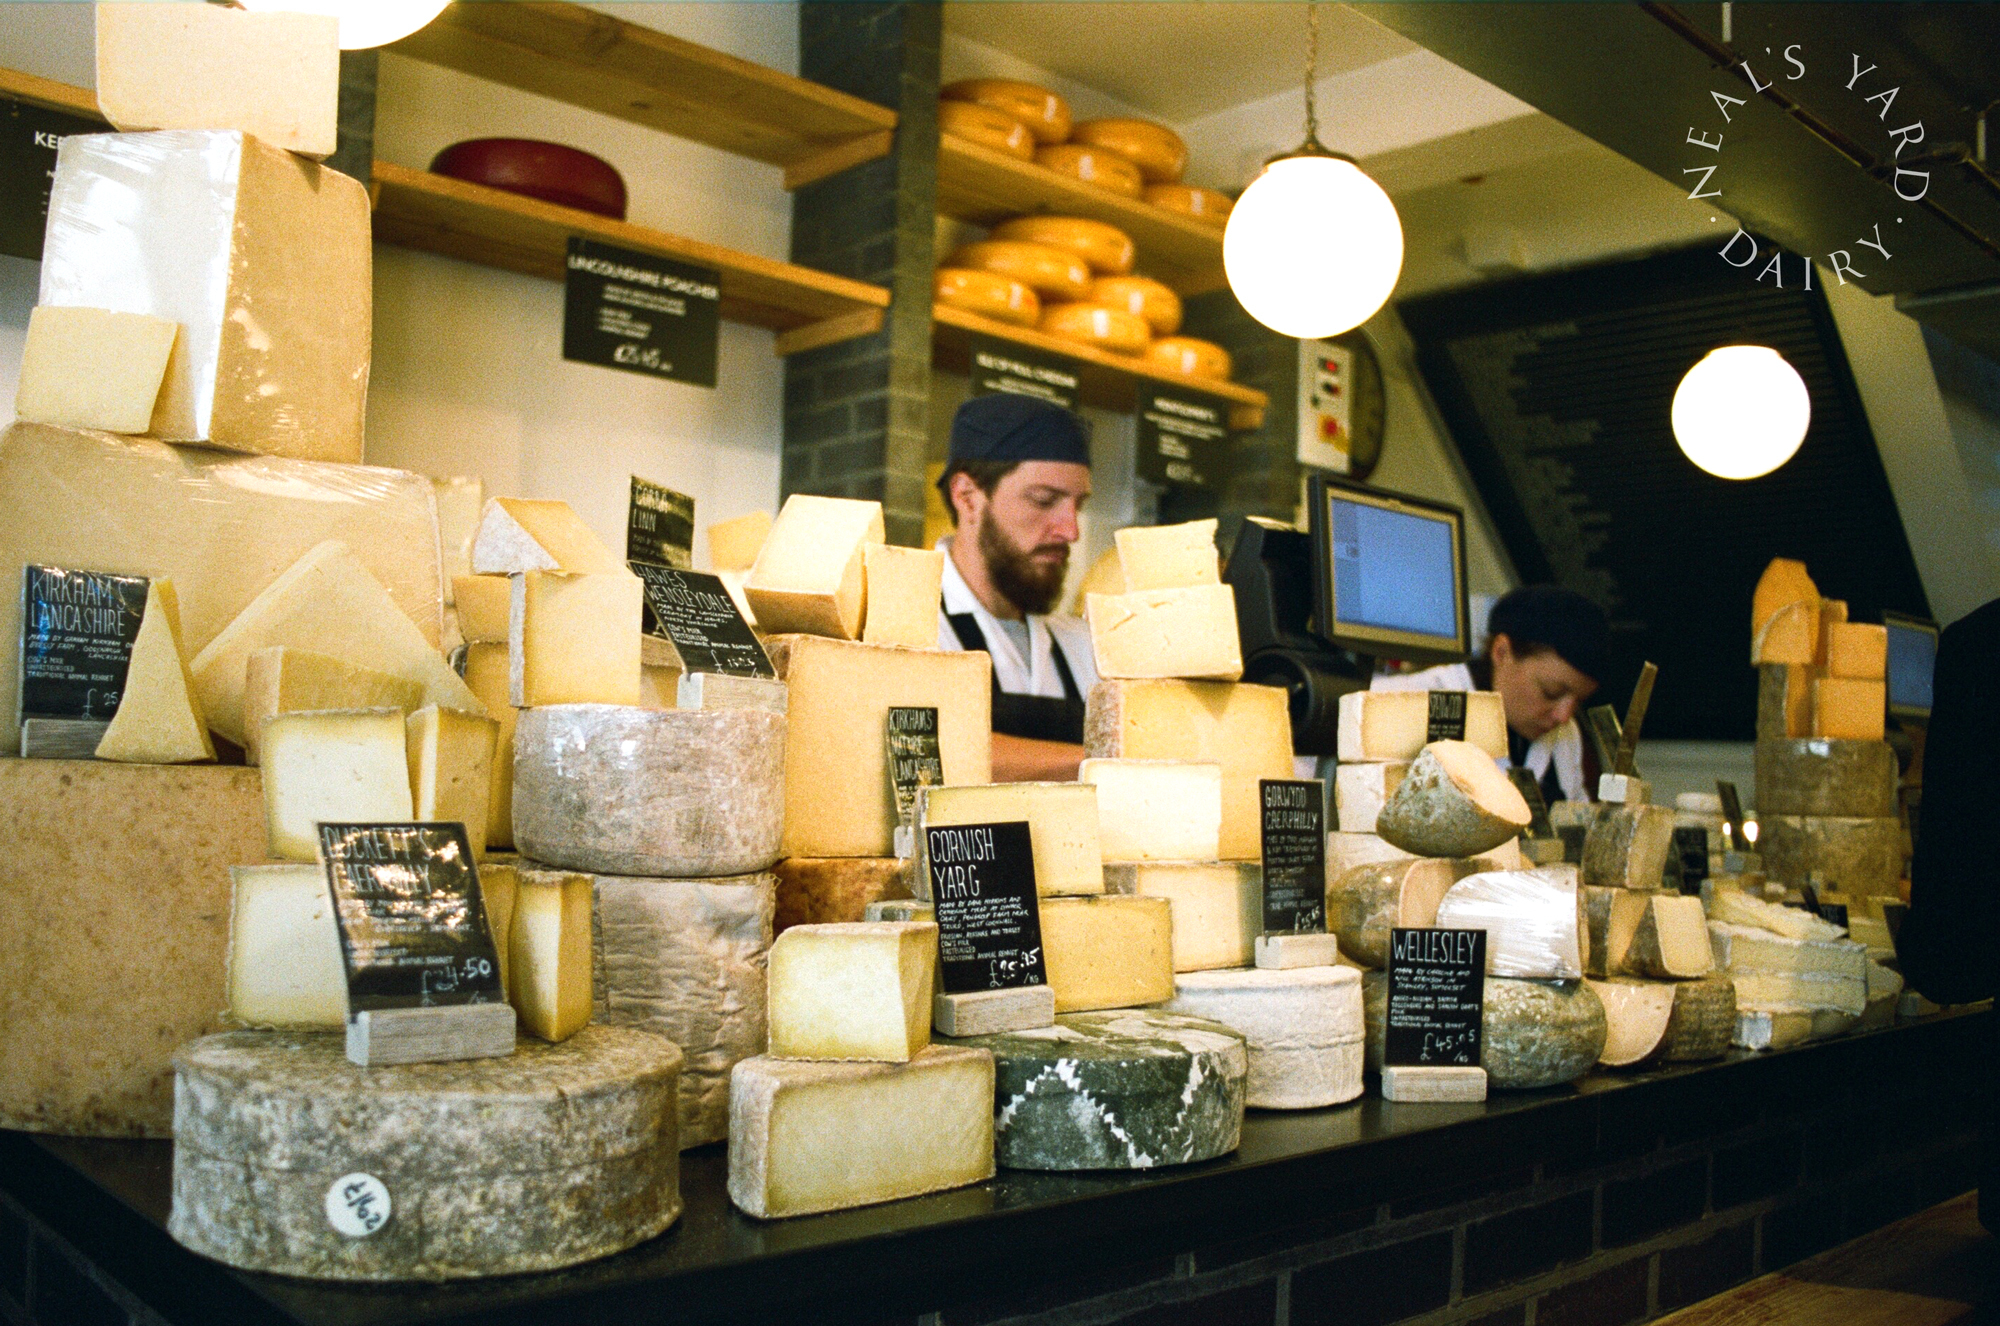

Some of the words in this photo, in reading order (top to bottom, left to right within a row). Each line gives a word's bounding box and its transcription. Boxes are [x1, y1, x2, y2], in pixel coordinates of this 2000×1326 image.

[34, 130, 59, 150] KE
[632, 508, 656, 533] LINN
[31, 570, 129, 610] KIRKHAM'S
[633, 564, 687, 589] HAWES
[645, 584, 736, 614] WENSLEYDALE
[30, 601, 126, 637] LANCASHIRE
[889, 709, 932, 731] KIRKHAM'S
[1265, 809, 1318, 831] CAERPHILLY
[324, 826, 434, 861] DUCKETT'S
[930, 828, 995, 863] CORNISH
[933, 864, 980, 899] YARG
[1392, 931, 1477, 964] WELLESLEY
